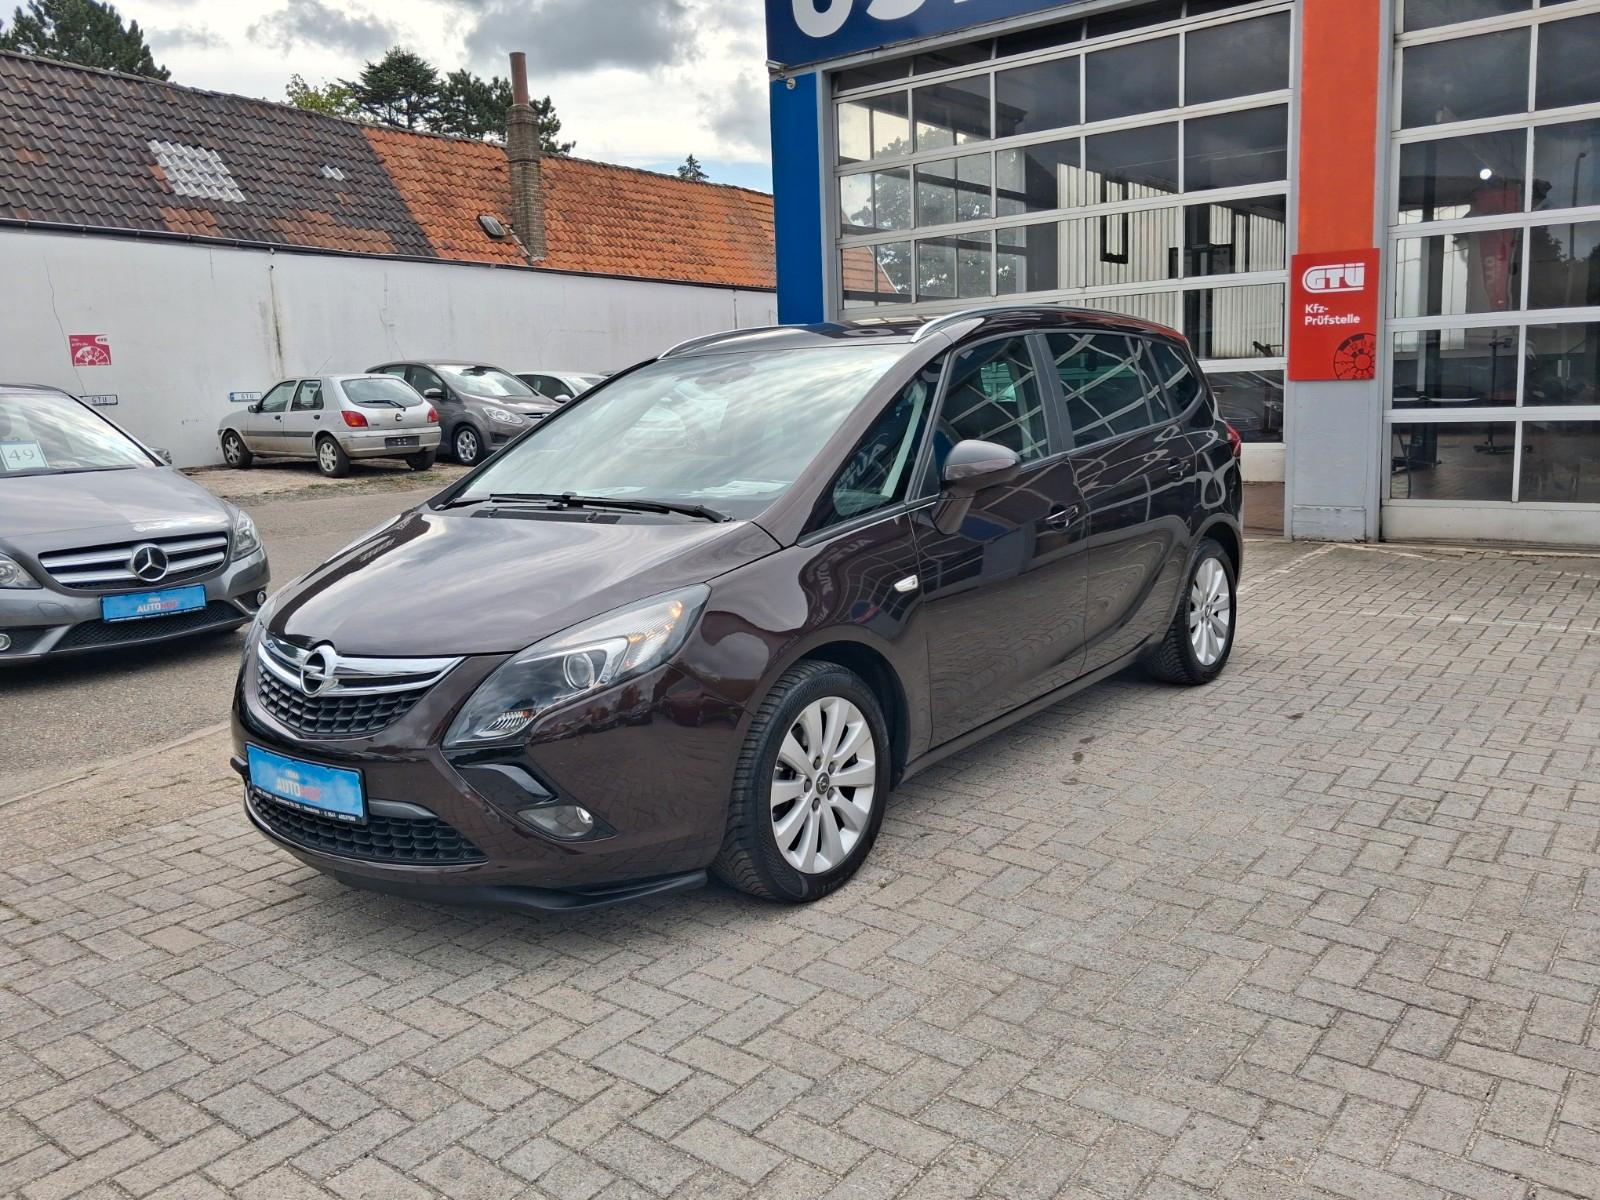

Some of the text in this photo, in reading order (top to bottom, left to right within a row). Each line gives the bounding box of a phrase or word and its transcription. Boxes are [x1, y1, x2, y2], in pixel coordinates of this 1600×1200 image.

[1302, 262, 1365, 293] GTÜ
[1305, 303, 1329, 313] Kfz-
[1305, 314, 1360, 326] Prüfstelle
[8, 448, 35, 461] 49
[276, 777, 321, 801] AUTO
